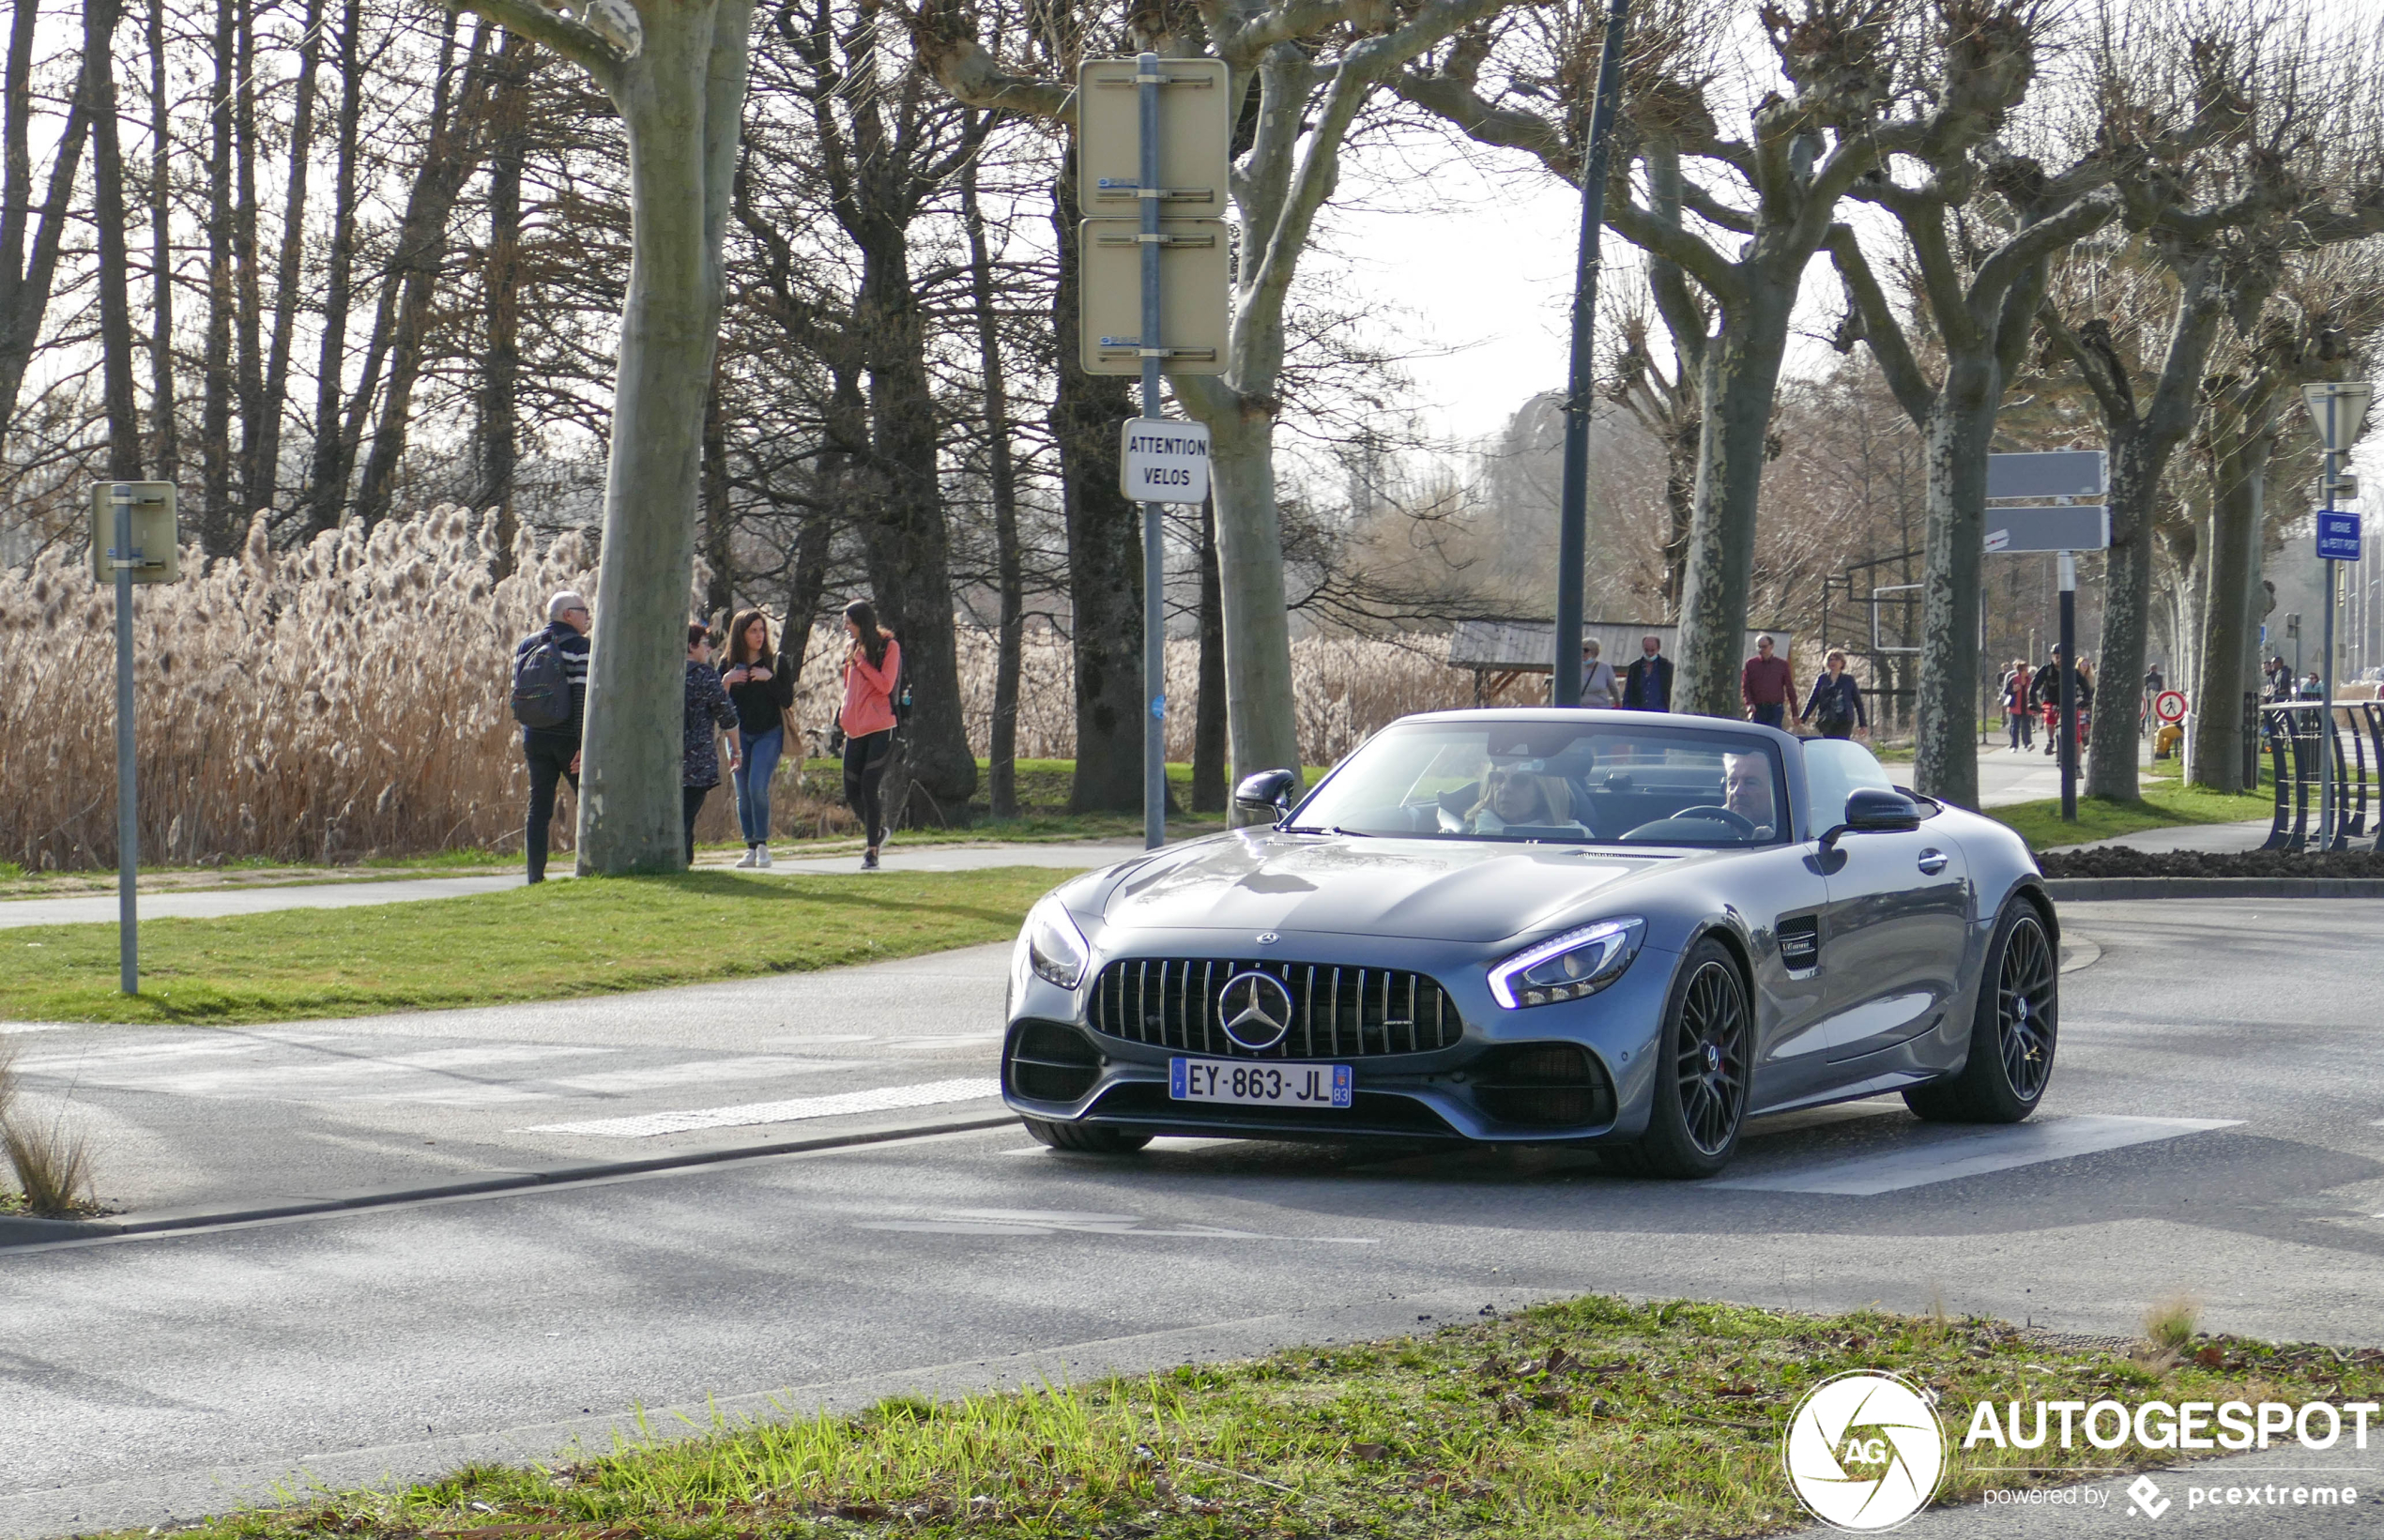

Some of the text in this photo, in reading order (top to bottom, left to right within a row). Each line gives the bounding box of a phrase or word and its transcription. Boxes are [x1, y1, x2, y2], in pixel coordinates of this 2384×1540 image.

[1129, 435, 1206, 456] ATTENTION
[1143, 467, 1190, 486] VELOS
[1176, 1081, 1182, 1090] F
[1189, 1064, 1330, 1102] EY-863-JL
[1334, 1088, 1349, 1102] 83
